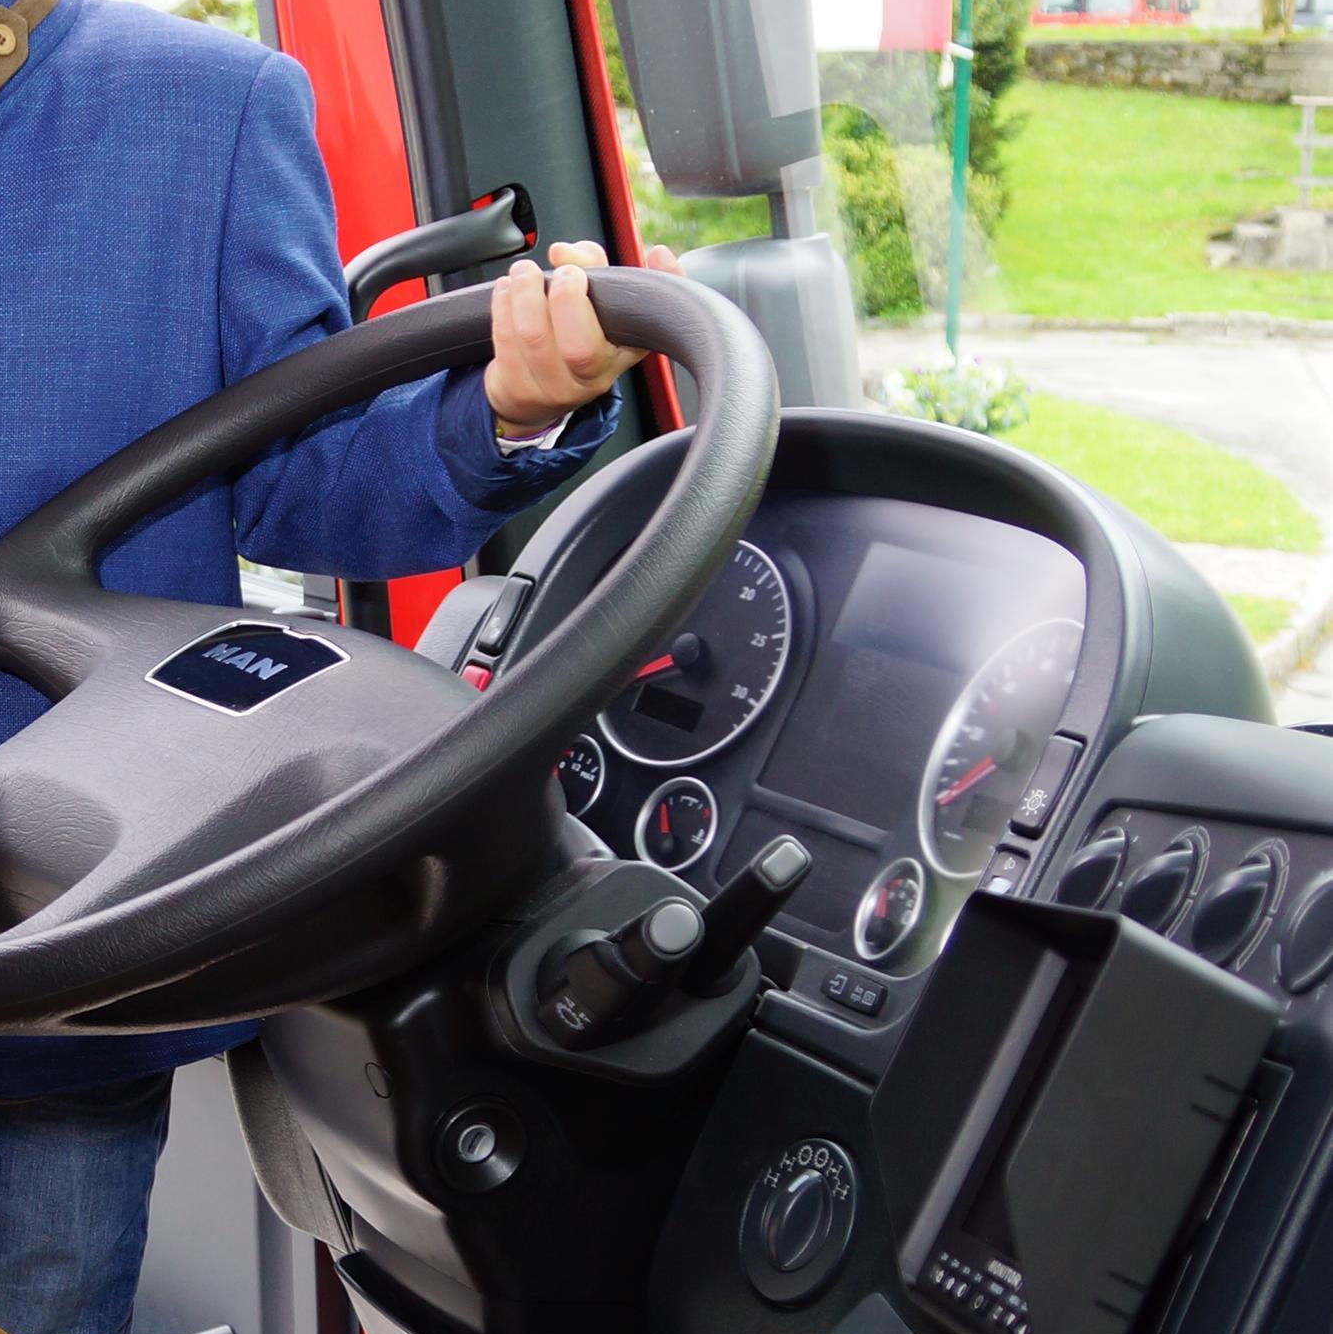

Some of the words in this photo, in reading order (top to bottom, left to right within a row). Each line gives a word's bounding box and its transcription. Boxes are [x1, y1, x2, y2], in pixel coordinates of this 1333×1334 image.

[739, 586, 756, 601] 20
[750, 633, 768, 647] 25
[202, 642, 288, 681] MAN
[731, 684, 748, 699] 30
